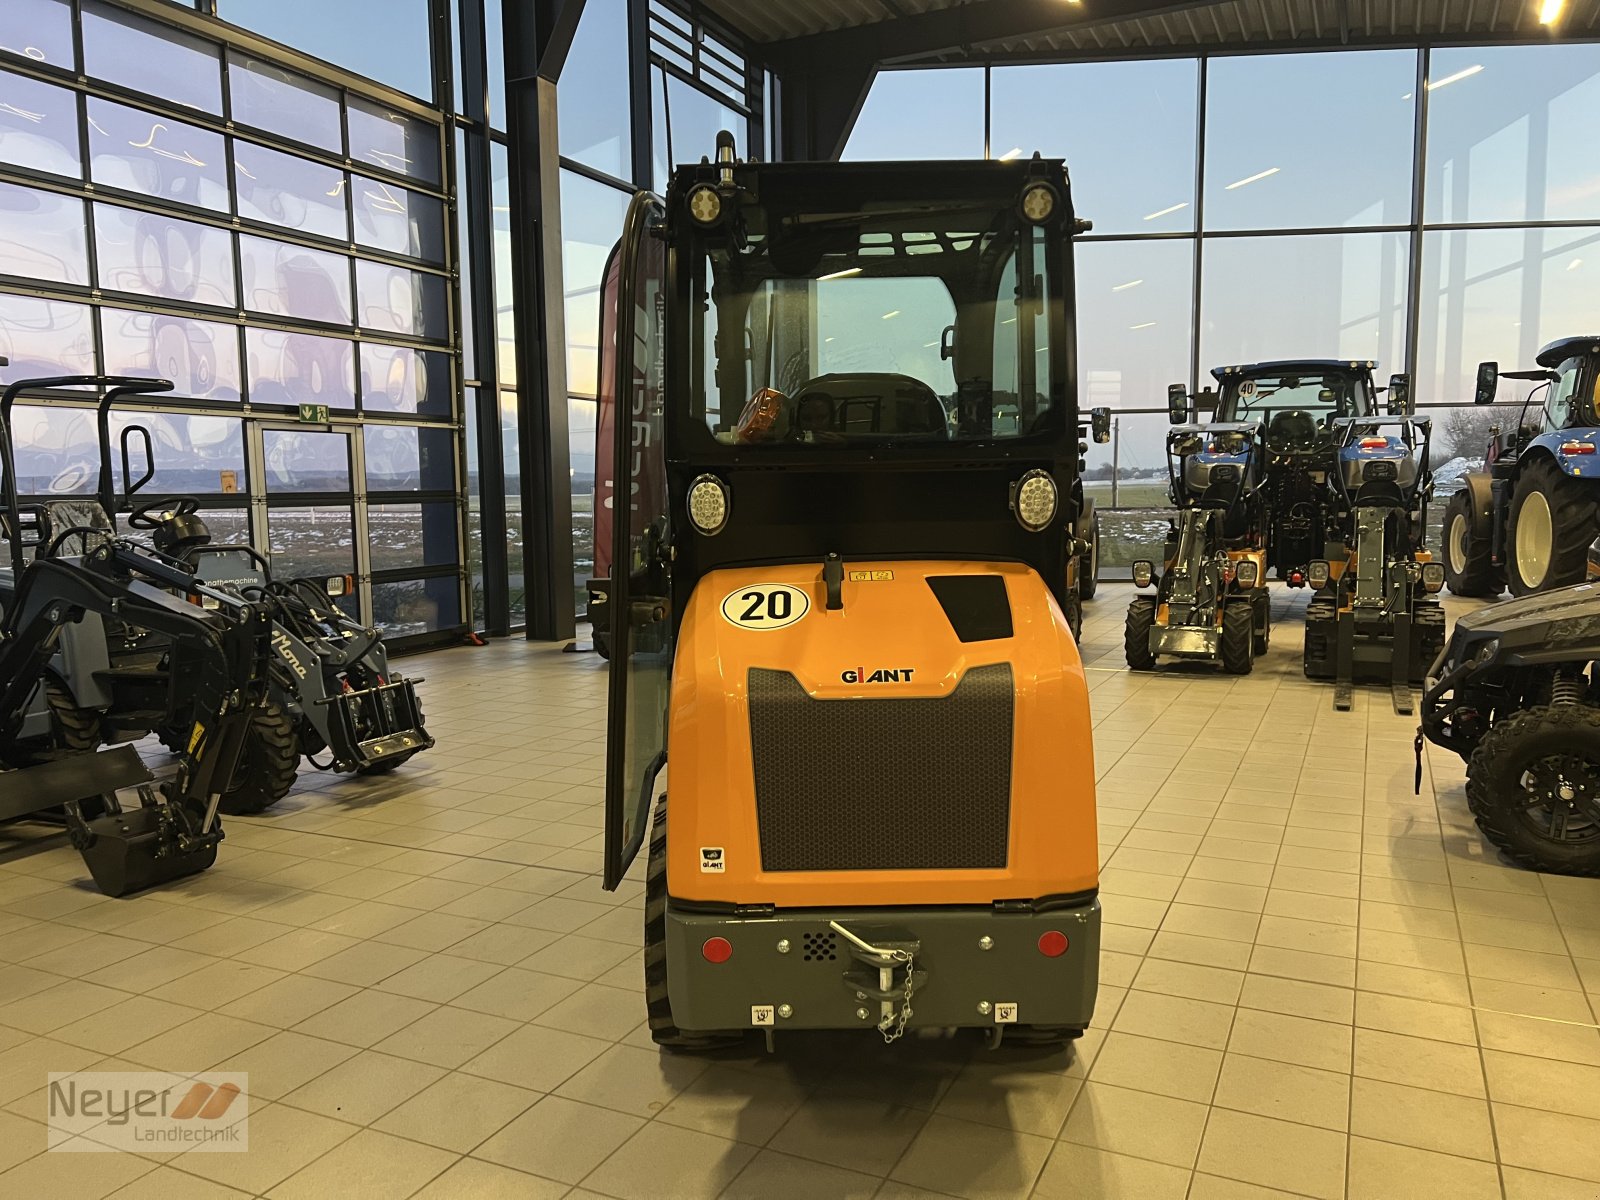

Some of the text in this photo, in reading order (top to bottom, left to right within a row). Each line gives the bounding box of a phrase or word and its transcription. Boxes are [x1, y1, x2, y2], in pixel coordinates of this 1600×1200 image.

[1241, 383, 1253, 395] 40
[740, 591, 791, 620] 20
[271, 635, 307, 680] Mona
[841, 667, 914, 683] GIANT
